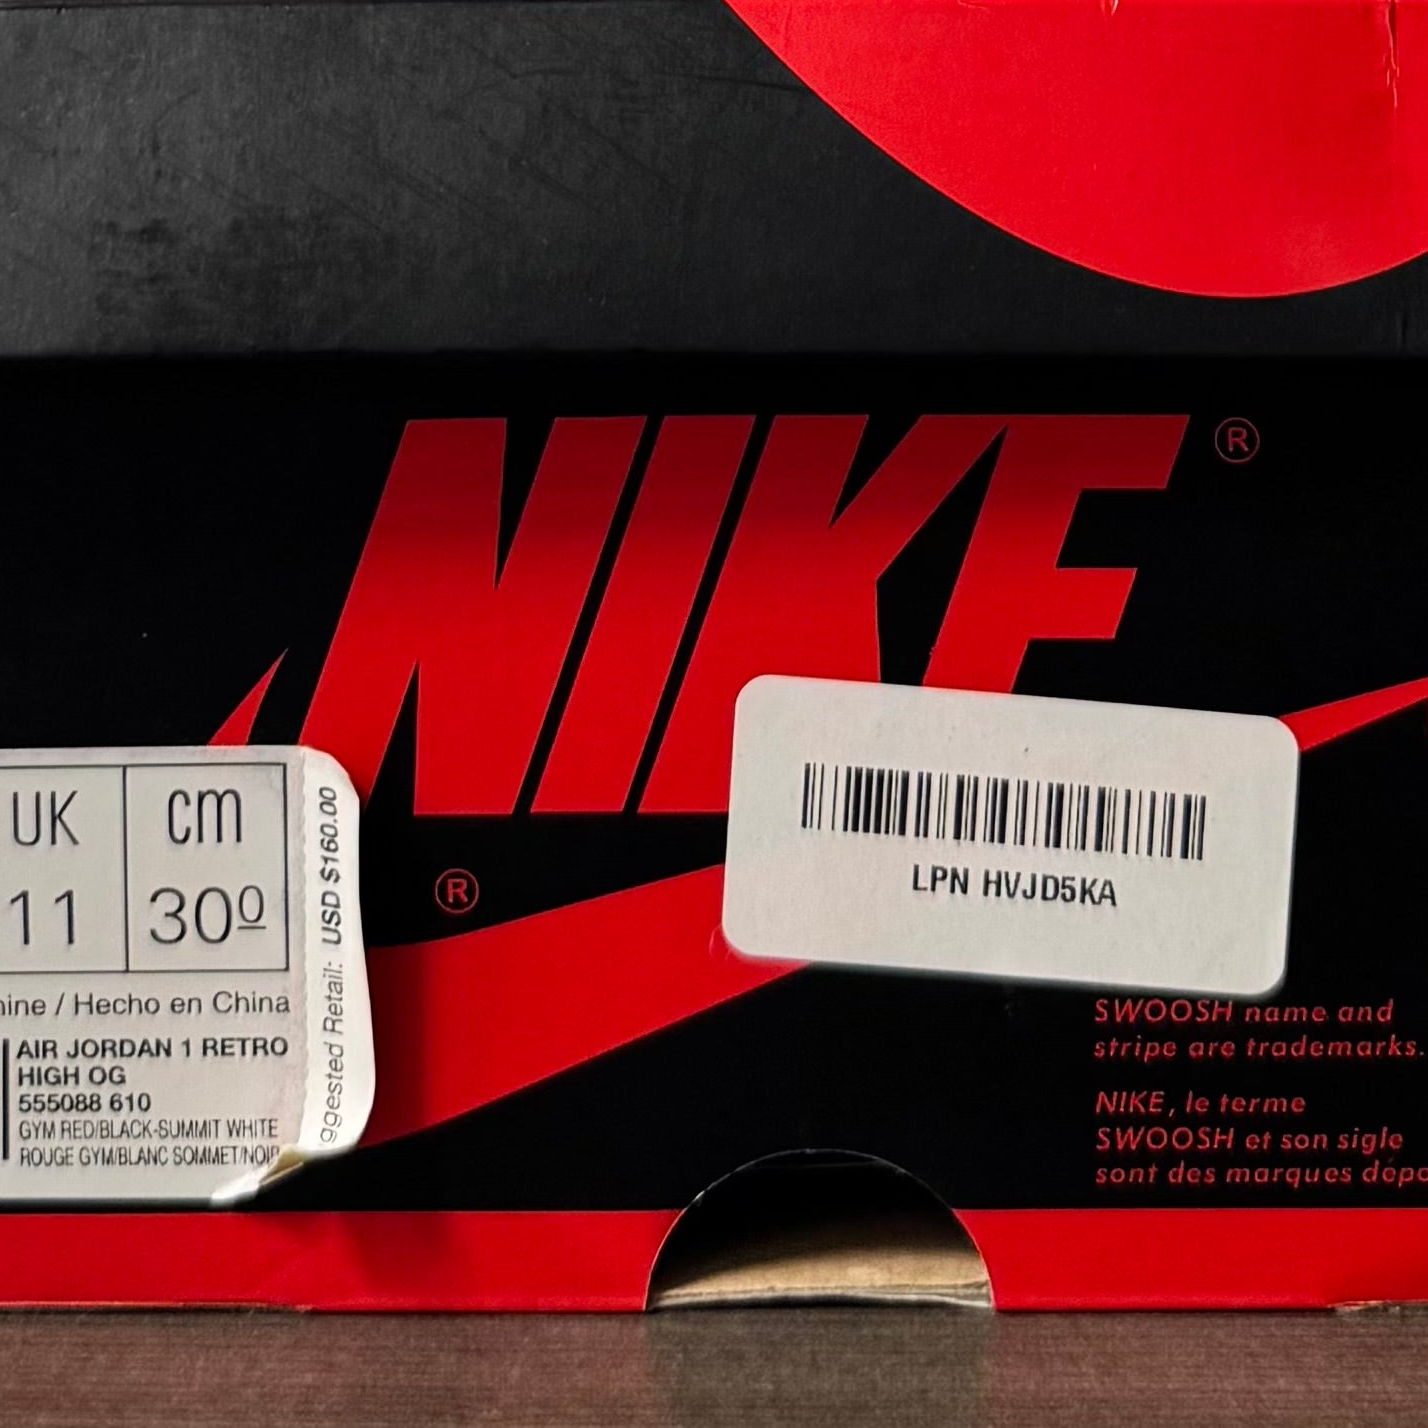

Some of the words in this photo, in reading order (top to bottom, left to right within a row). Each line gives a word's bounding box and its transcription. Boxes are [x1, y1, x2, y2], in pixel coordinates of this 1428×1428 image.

[12, 790, 79, 847] UK
[167, 789, 242, 845] cm
[318, 786, 341, 884] $160.00
[912, 864, 969, 896] LPN
[982, 869, 1117, 908] HVJD5KA
[10, 889, 75, 946] 11
[320, 890, 342, 946] USD
[53, 992, 66, 1016] /
[74, 992, 161, 1016] Hecho
[170, 997, 202, 1015] en
[212, 990, 291, 1014] China
[322, 961, 344, 1035] Retail:
[1094, 998, 1233, 1024] SWOOSH
[1244, 1006, 1327, 1024] name
[1337, 998, 1394, 1024] and
[16, 1039, 58, 1060] AIR
[66, 1038, 172, 1060] JORDAN
[180, 1038, 192, 1058] 1
[202, 1036, 289, 1058] RETRO
[1093, 1035, 1177, 1063] stripe
[1188, 1041, 1236, 1060] are
[1246, 1033, 1424, 1059] trademarks.
[18, 1066, 80, 1087] HIGH
[88, 1065, 127, 1086] OG
[18, 1093, 102, 1114] 555088
[109, 1092, 152, 1113] 610
[1095, 1091, 1174, 1117] NIKE,
[1185, 1091, 1210, 1115] le
[1219, 1094, 1306, 1114] terme
[18, 1120, 56, 1142] GYM
[60, 1118, 221, 1140] RED/BLACK-SUMMIT
[226, 1118, 278, 1139] WHITE
[1096, 1126, 1234, 1152] SWOOSH
[1244, 1131, 1272, 1152] et
[1280, 1133, 1328, 1152] son
[1337, 1126, 1404, 1155] sigle
[20, 1146, 74, 1167] ROUGE
[78, 1146, 169, 1167] GYM/BLANC
[1095, 1164, 1158, 1186] sont
[1167, 1161, 1216, 1185] des
[1225, 1167, 1352, 1189] marques
